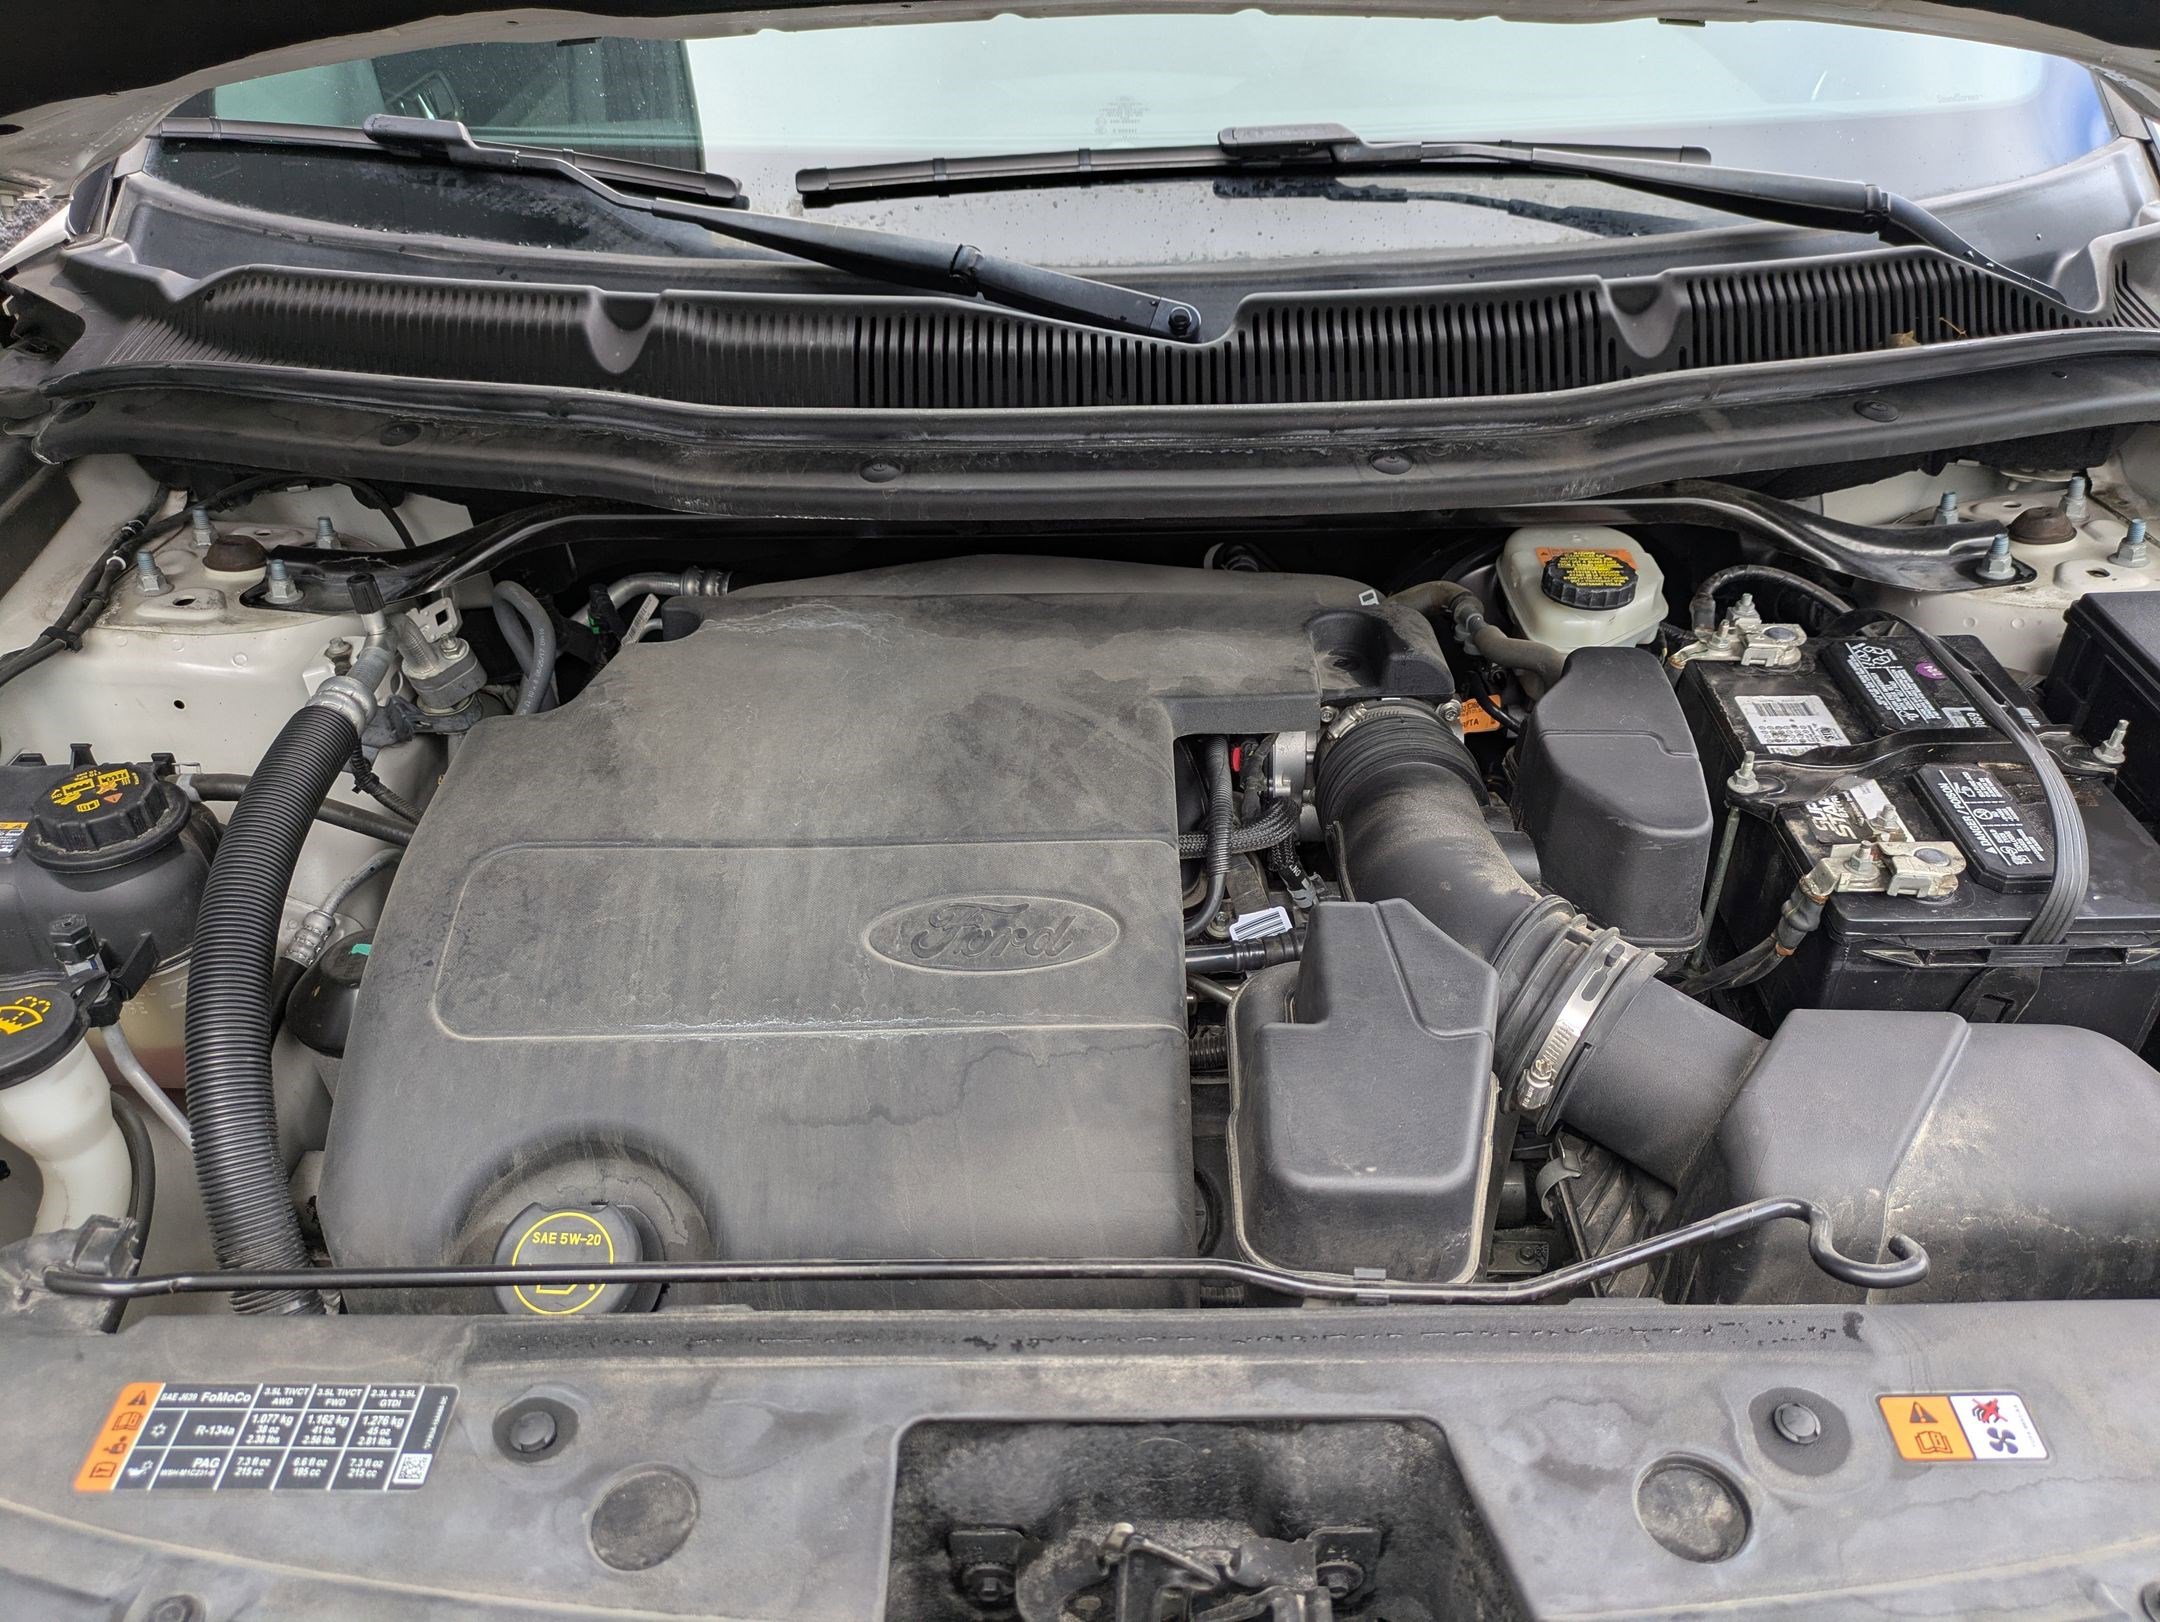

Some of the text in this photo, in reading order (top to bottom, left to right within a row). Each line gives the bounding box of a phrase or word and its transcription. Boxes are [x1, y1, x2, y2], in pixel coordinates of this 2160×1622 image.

[1938, 783, 1965, 810] POISON
[1962, 815, 1993, 847] DANGER
[910, 902, 1077, 960] Ford
[532, 1232, 602, 1246] SAE 5W-20
[264, 1387, 282, 1396] 3.5L
[317, 1388, 335, 1397] 3.5L
[370, 1389, 388, 1398] 2.3L
[161, 1392, 178, 1401] SAE
[200, 1391, 252, 1403] FoMoCo
[271, 1397, 294, 1406] AWD
[325, 1398, 347, 1407] FWD
[252, 1413, 294, 1427] 1.077 kg
[308, 1414, 350, 1428] 1.162 kg
[363, 1415, 405, 1429] 1.276 kg
[195, 1424, 235, 1436] R-134a
[256, 1425, 280, 1434] 38 oz
[312, 1425, 336, 1435] 41 oz
[367, 1426, 391, 1436] 45 oz
[266, 1435, 280, 1444] lbs
[322, 1435, 336, 1445] lbs
[377, 1436, 392, 1446] lbs
[192, 1457, 221, 1469] PAG
[237, 1456, 251, 1466] 7.3
[259, 1458, 271, 1467] oz
[293, 1457, 308, 1467] 6.6
[316, 1458, 328, 1468] oz
[349, 1458, 364, 1467] 7.3
[372, 1460, 384, 1468] oz
[233, 1466, 264, 1477] 215 cc
[293, 1467, 321, 1477] 195 cc
[348, 1467, 378, 1477] 215 cc
